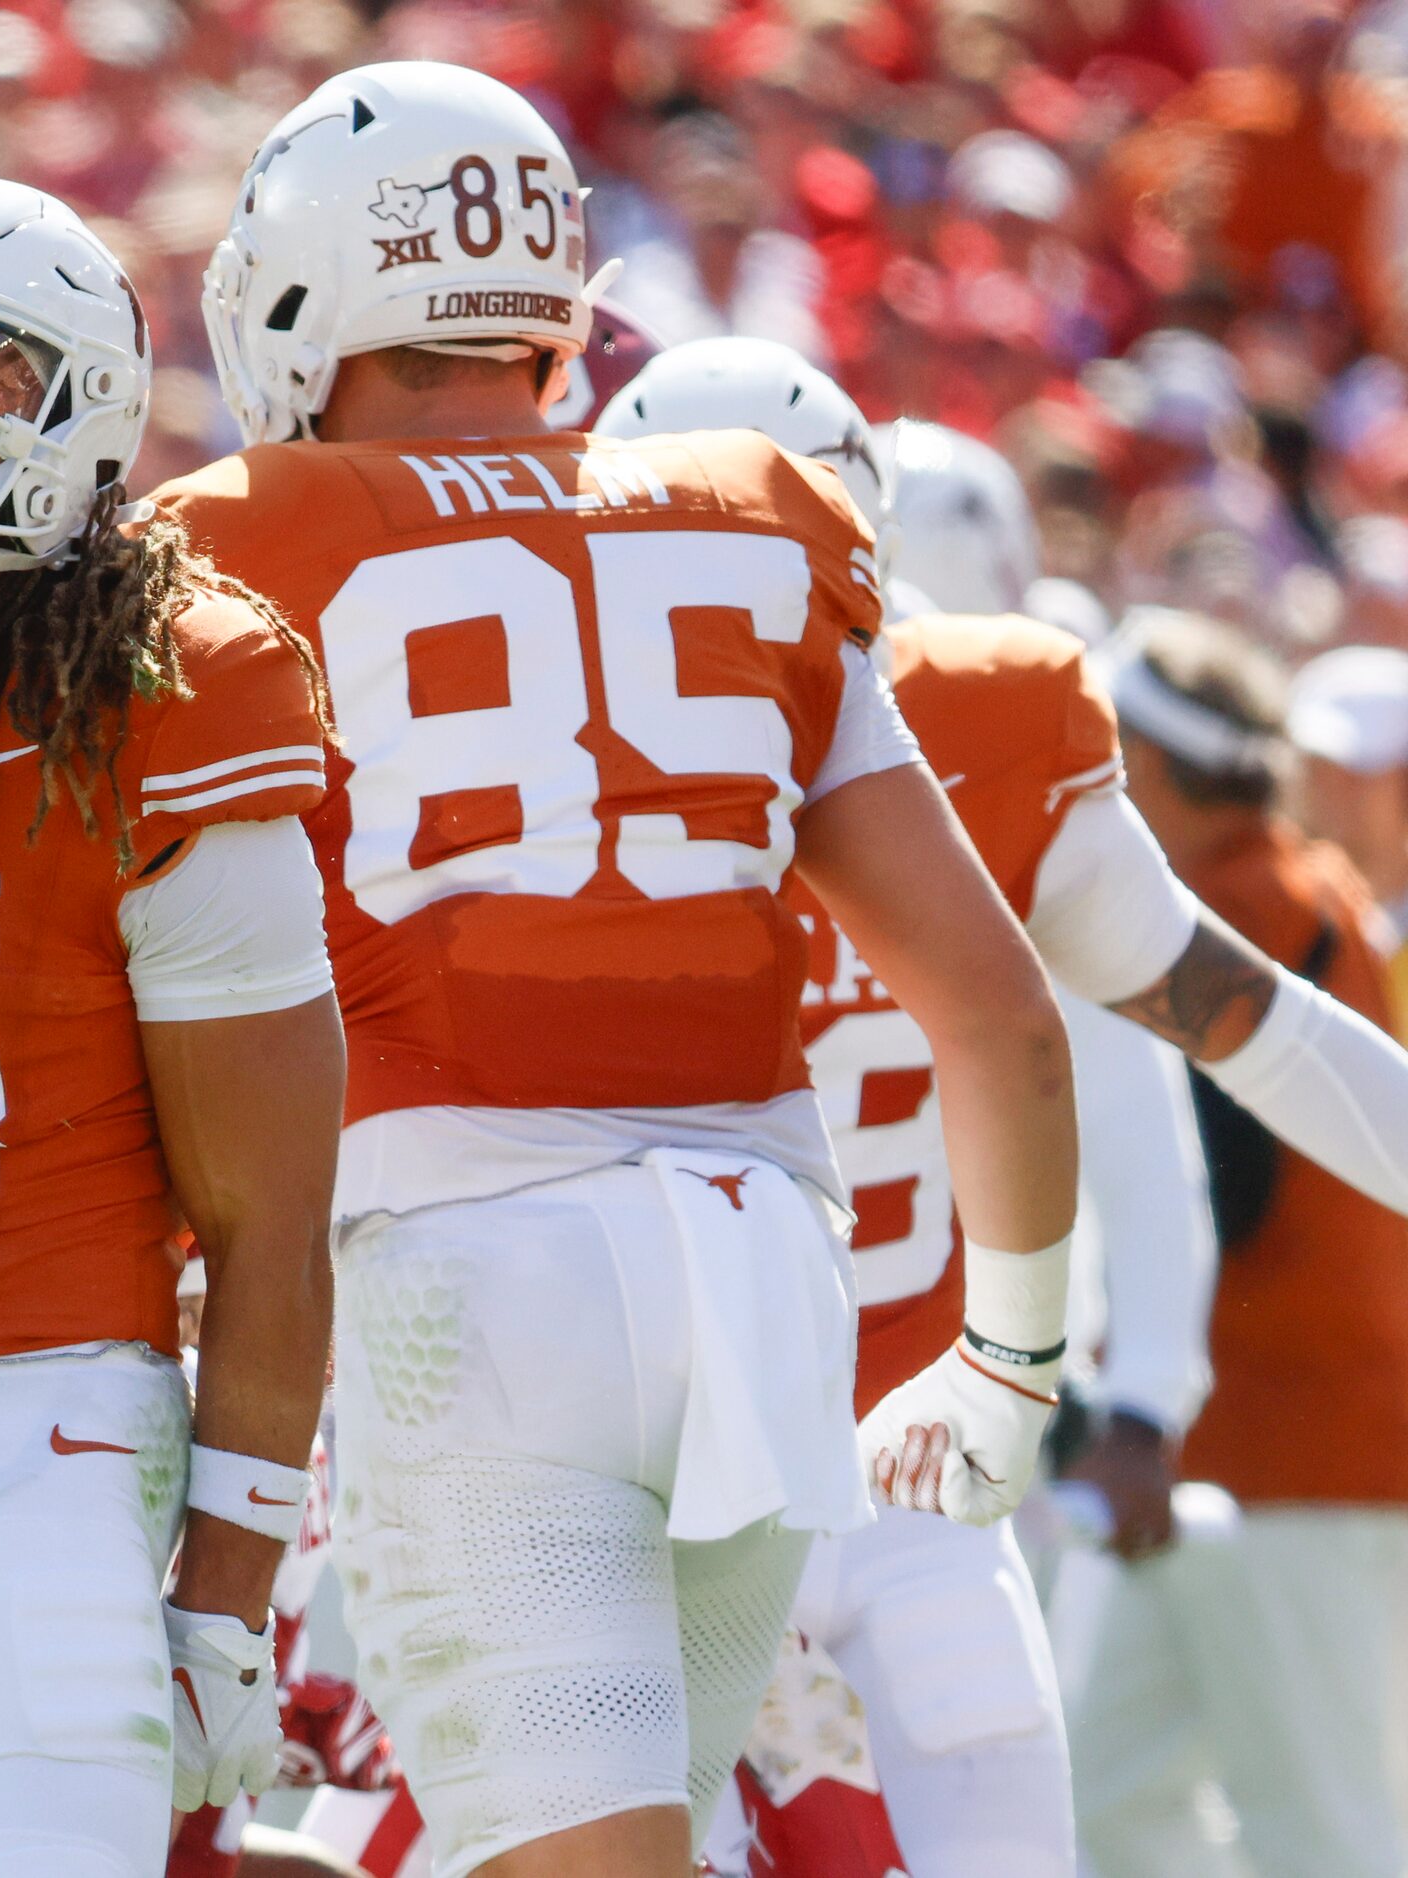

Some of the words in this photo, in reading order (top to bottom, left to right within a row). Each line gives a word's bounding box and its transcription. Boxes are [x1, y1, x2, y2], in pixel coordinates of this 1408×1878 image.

[450, 154, 556, 260] 85
[371, 228, 442, 273] XII
[425, 289, 572, 325] LONGHORNS
[399, 451, 672, 517] HELM
[318, 530, 812, 926] 85
